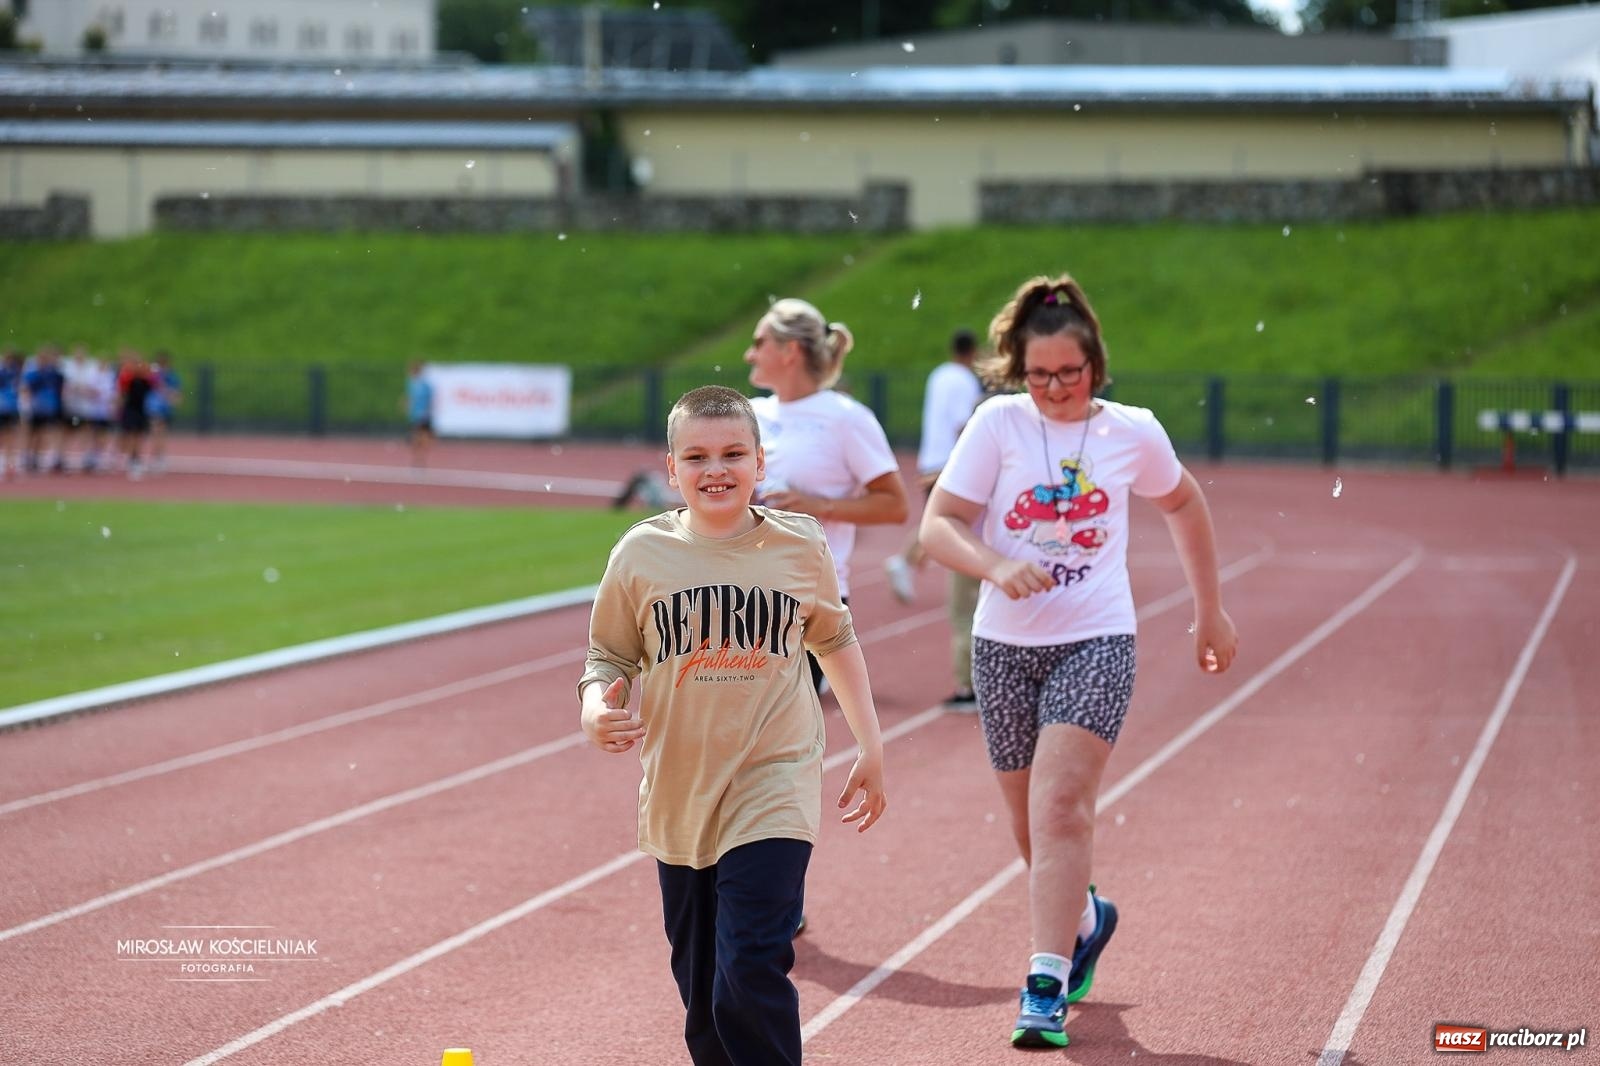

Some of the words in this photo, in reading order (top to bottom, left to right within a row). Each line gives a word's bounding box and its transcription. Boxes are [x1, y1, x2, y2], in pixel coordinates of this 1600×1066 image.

[1051, 563, 1092, 587] RFS
[651, 584, 801, 665] DETROIT
[675, 636, 769, 689] Authentic
[716, 674, 755, 682] SIXTY-TWO
